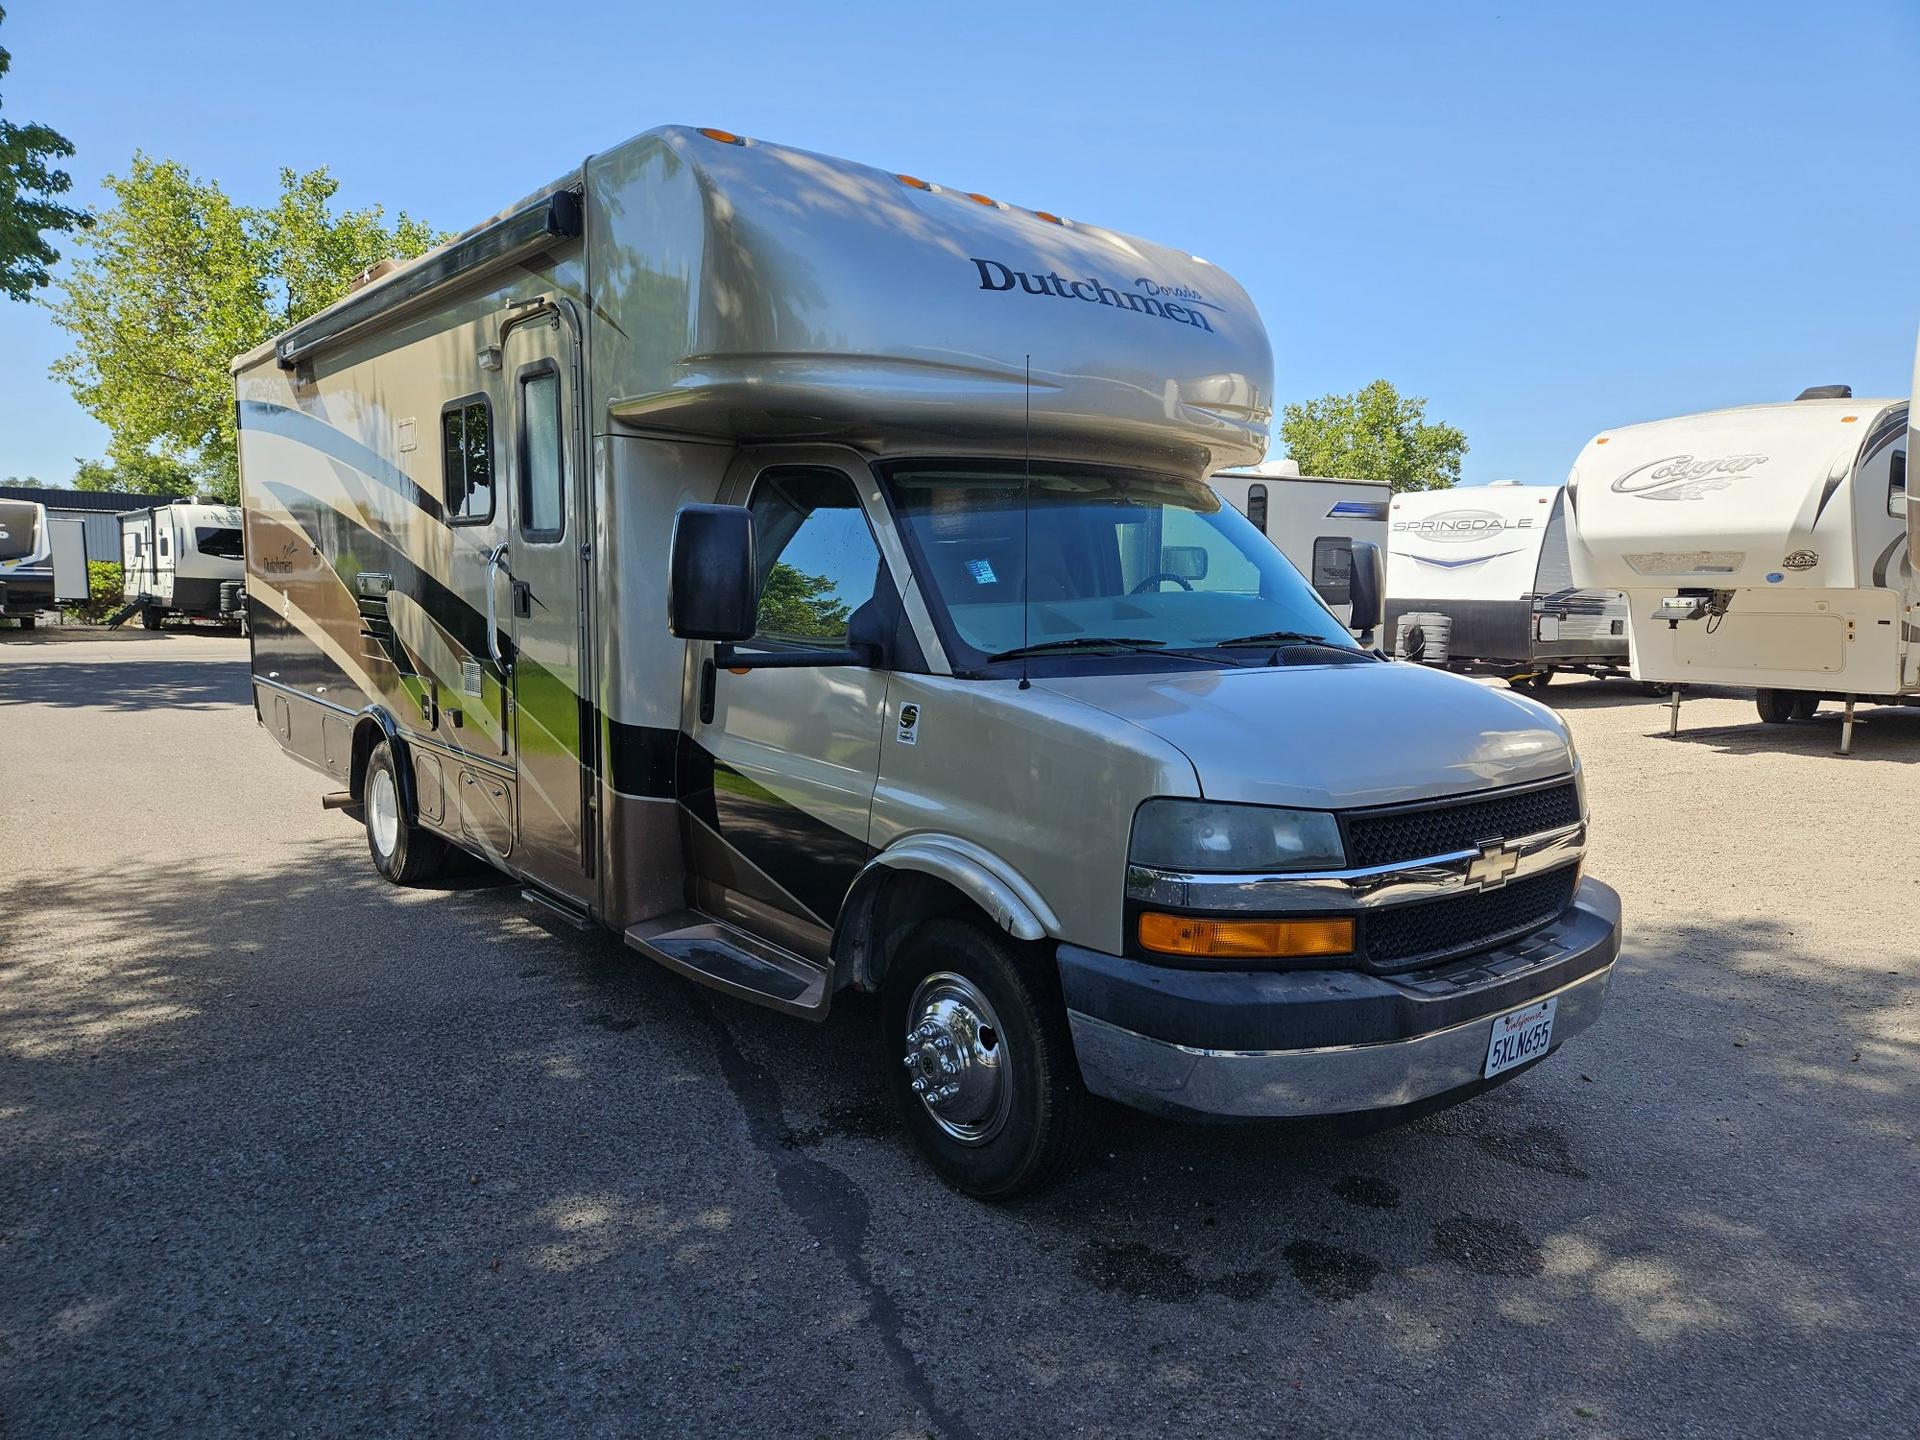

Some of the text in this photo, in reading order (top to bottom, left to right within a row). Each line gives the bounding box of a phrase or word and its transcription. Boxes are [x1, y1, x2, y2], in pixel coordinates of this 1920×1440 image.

[970, 257, 1214, 333] Dutchmen
[1611, 454, 1769, 494] Cougar
[1392, 518, 1534, 532] SPRINGDALE
[1505, 1011, 1545, 1032] California
[1491, 1020, 1551, 1069] 5XLN655
